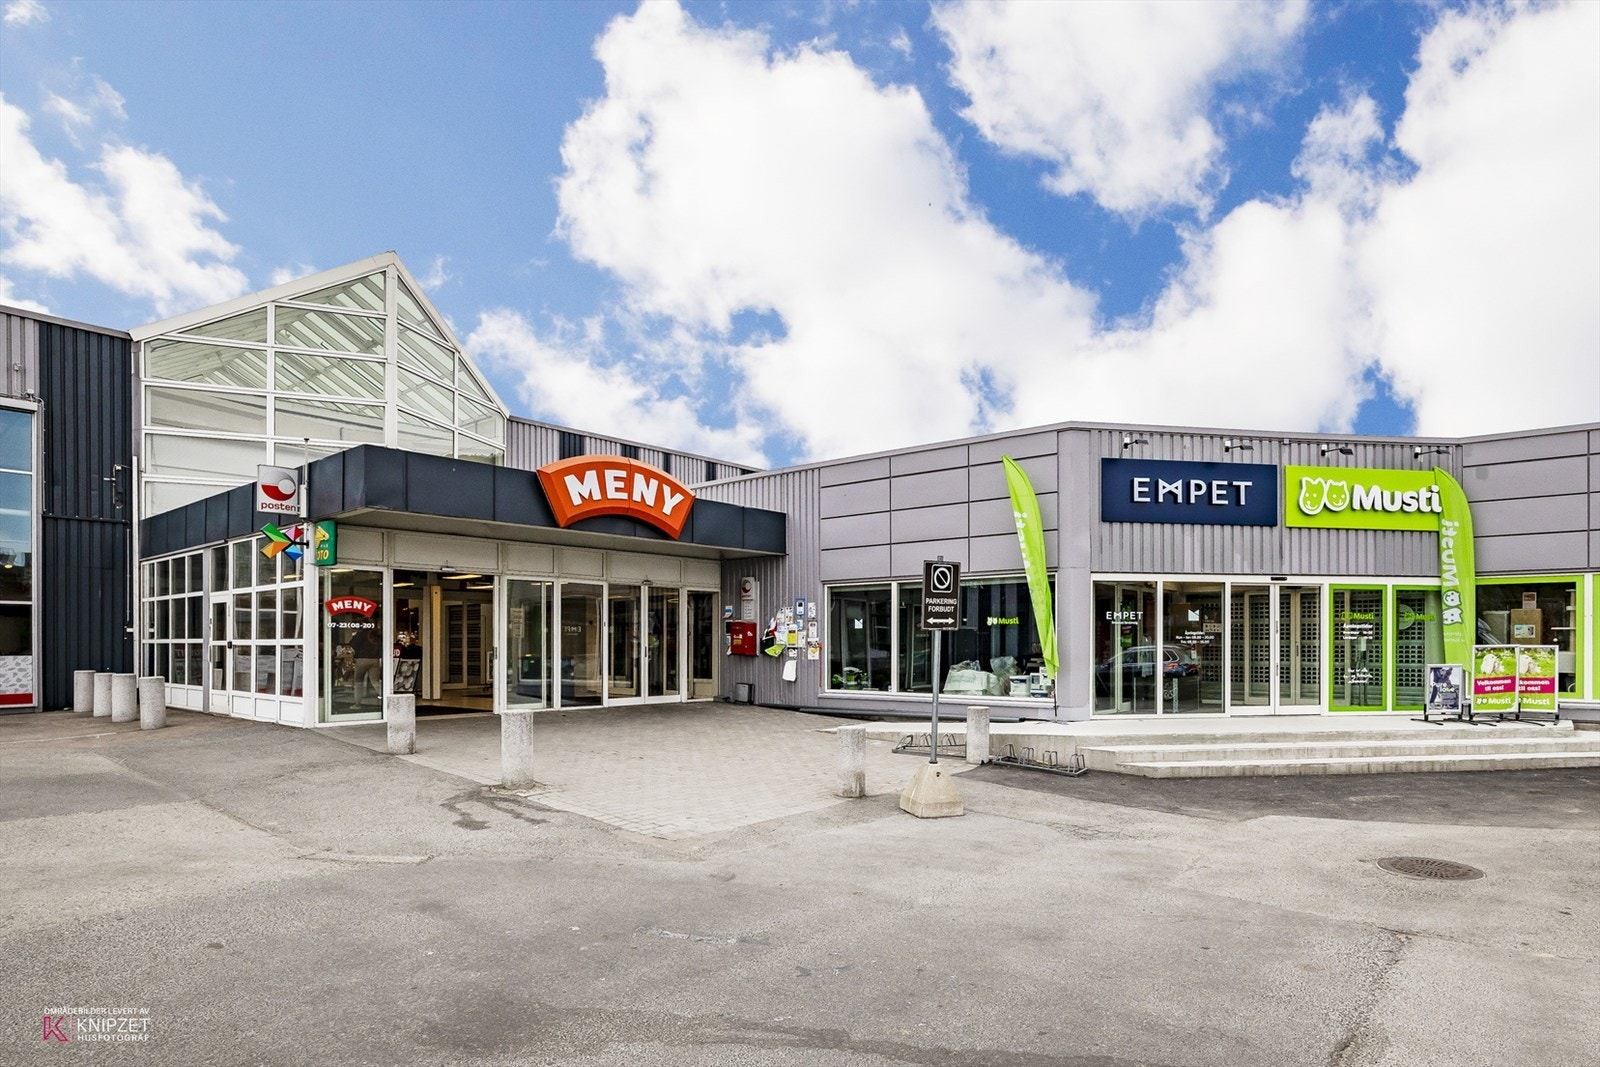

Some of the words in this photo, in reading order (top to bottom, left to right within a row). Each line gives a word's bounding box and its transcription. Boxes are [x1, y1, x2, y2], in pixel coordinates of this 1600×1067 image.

[563, 469, 685, 516] MENY
[1133, 477, 1253, 506] EMPET
[1352, 484, 1443, 513] Musti
[260, 501, 297, 512] posten
[331, 600, 372, 612] MENY
[1106, 611, 1144, 620] EMPET
[1353, 612, 1375, 620] Musti
[998, 617, 1019, 625] Musti
[1488, 697, 1512, 705] Musti
[1523, 697, 1550, 705] Musti
